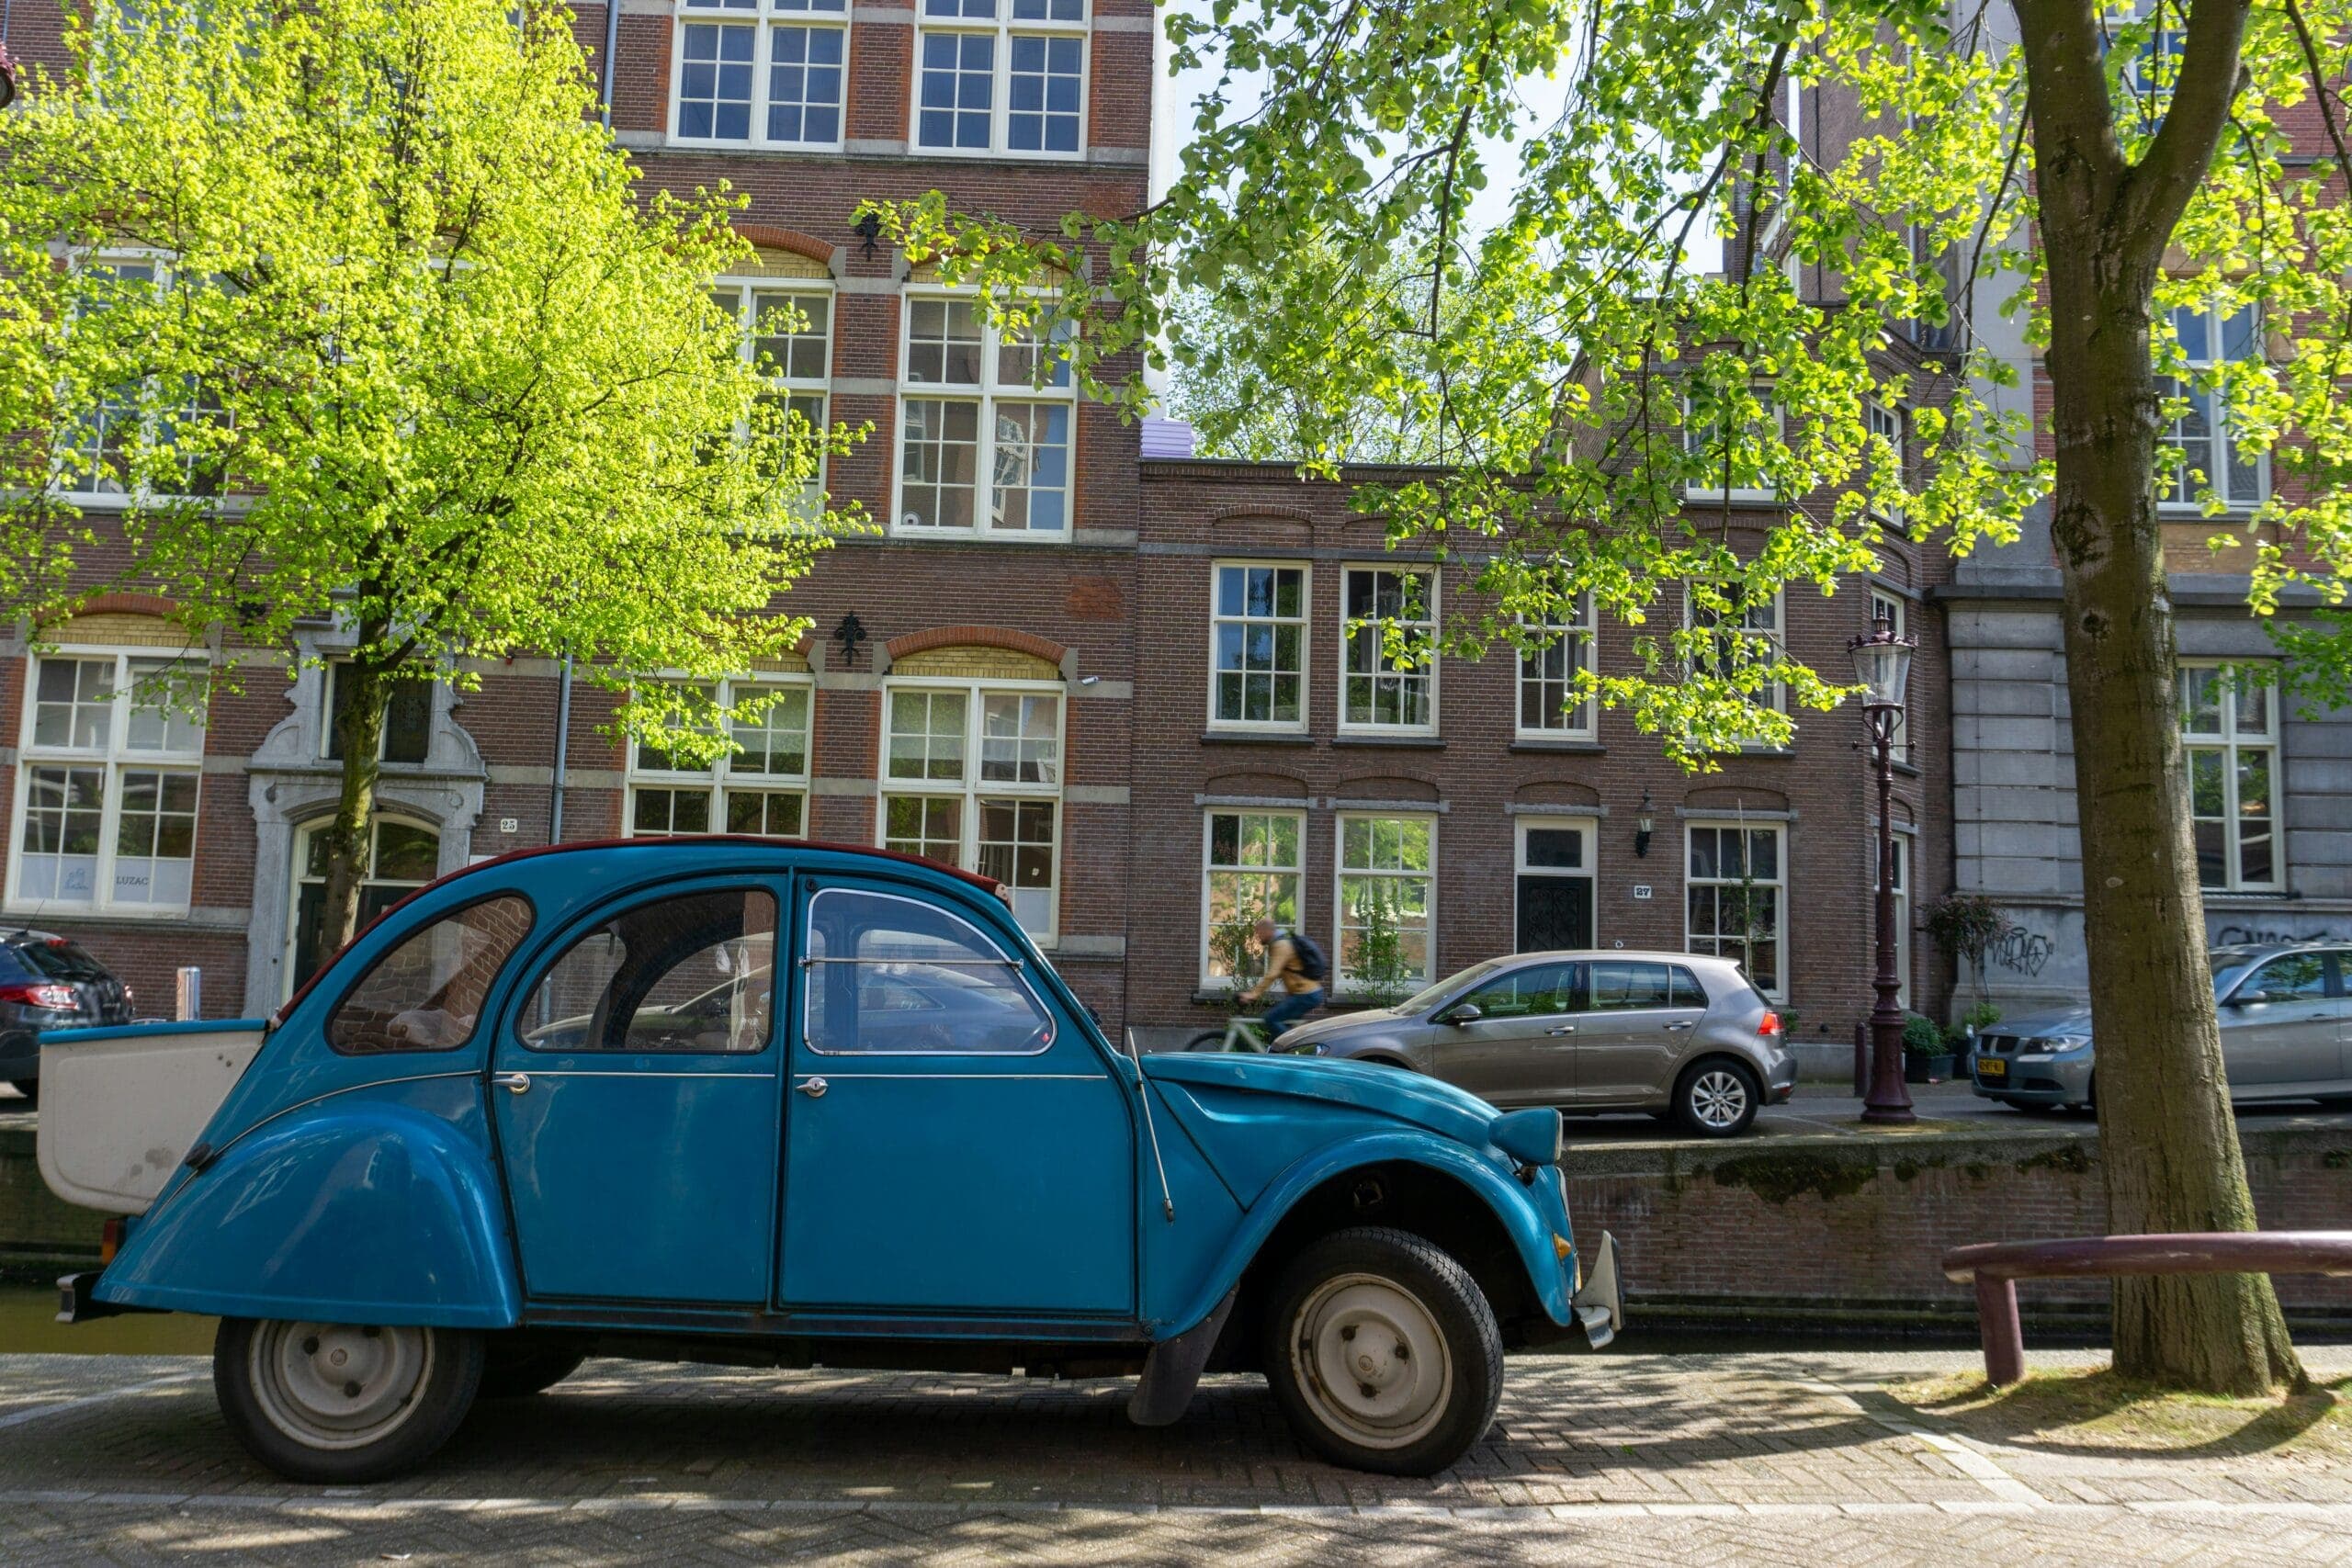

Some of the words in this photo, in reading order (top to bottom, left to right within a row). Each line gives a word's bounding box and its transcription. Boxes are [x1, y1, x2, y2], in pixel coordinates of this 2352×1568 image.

[503, 820, 515, 829] 25
[116, 875, 149, 886] LUZAC
[1636, 887, 1650, 897] 27
